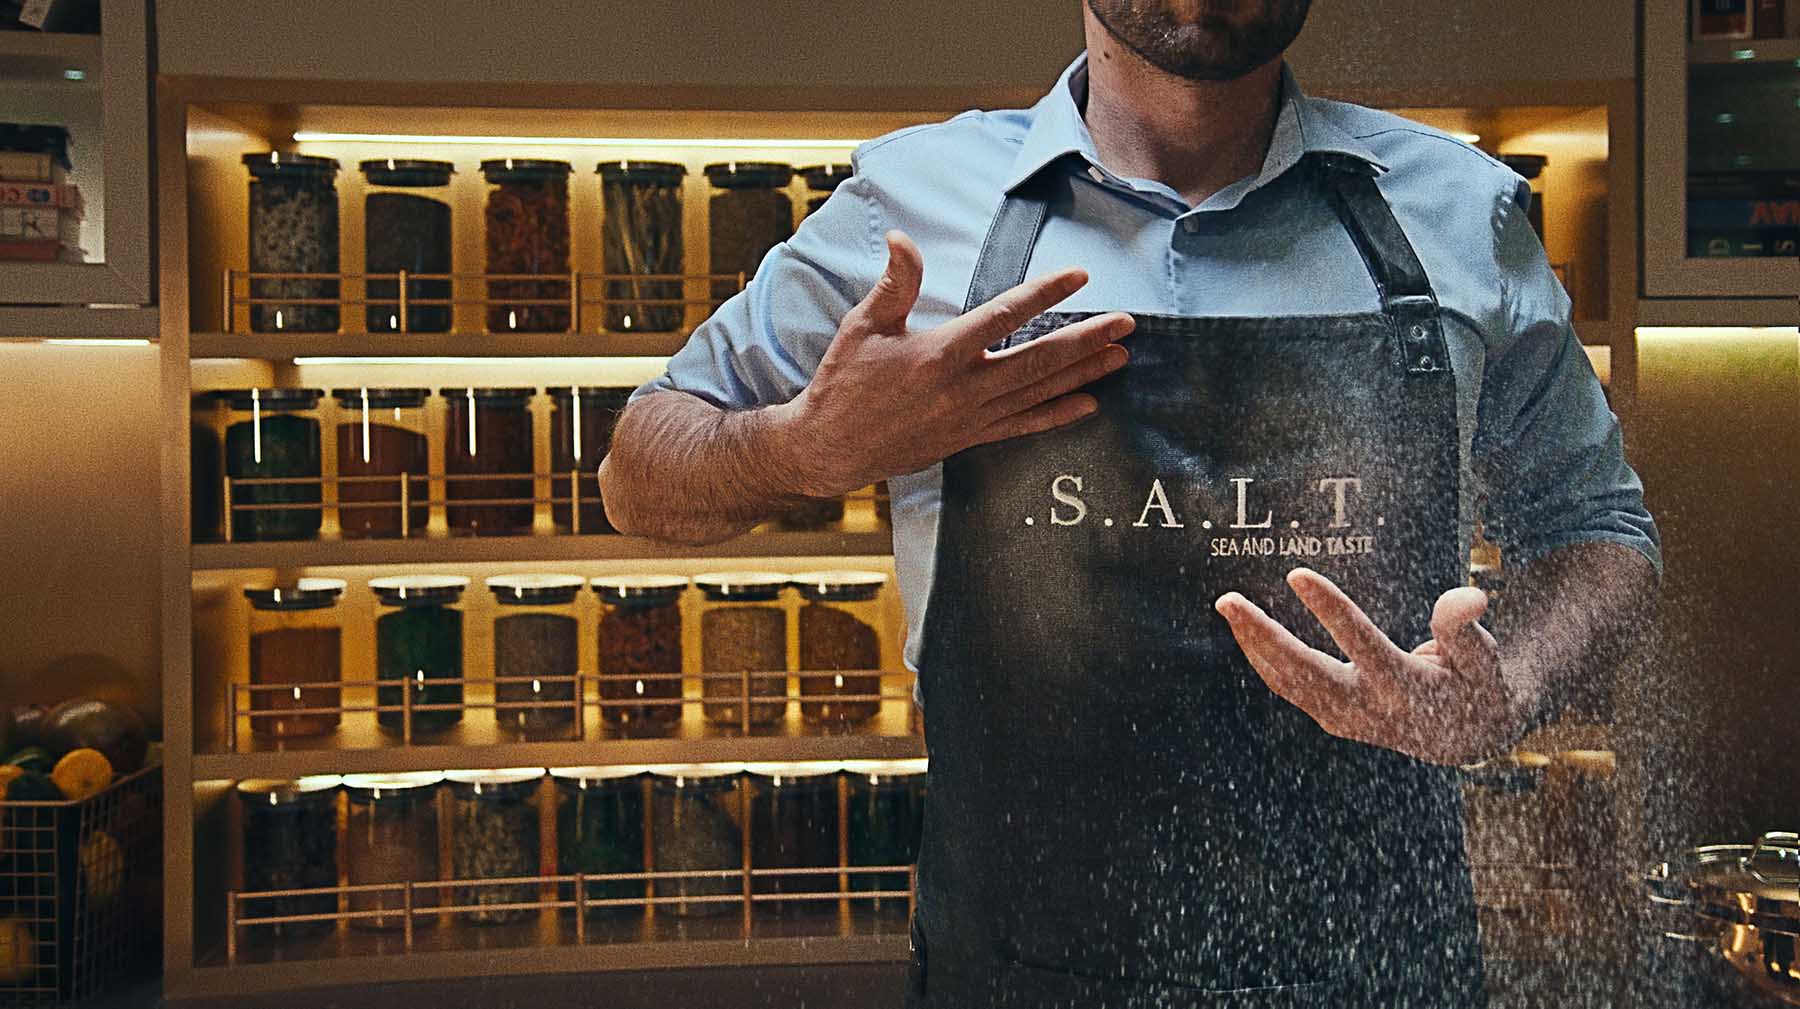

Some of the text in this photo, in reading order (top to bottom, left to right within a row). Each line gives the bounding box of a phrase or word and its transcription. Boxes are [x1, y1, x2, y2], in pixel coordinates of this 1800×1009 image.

[1210, 534, 1374, 556] SEA AND LAND TASTE
